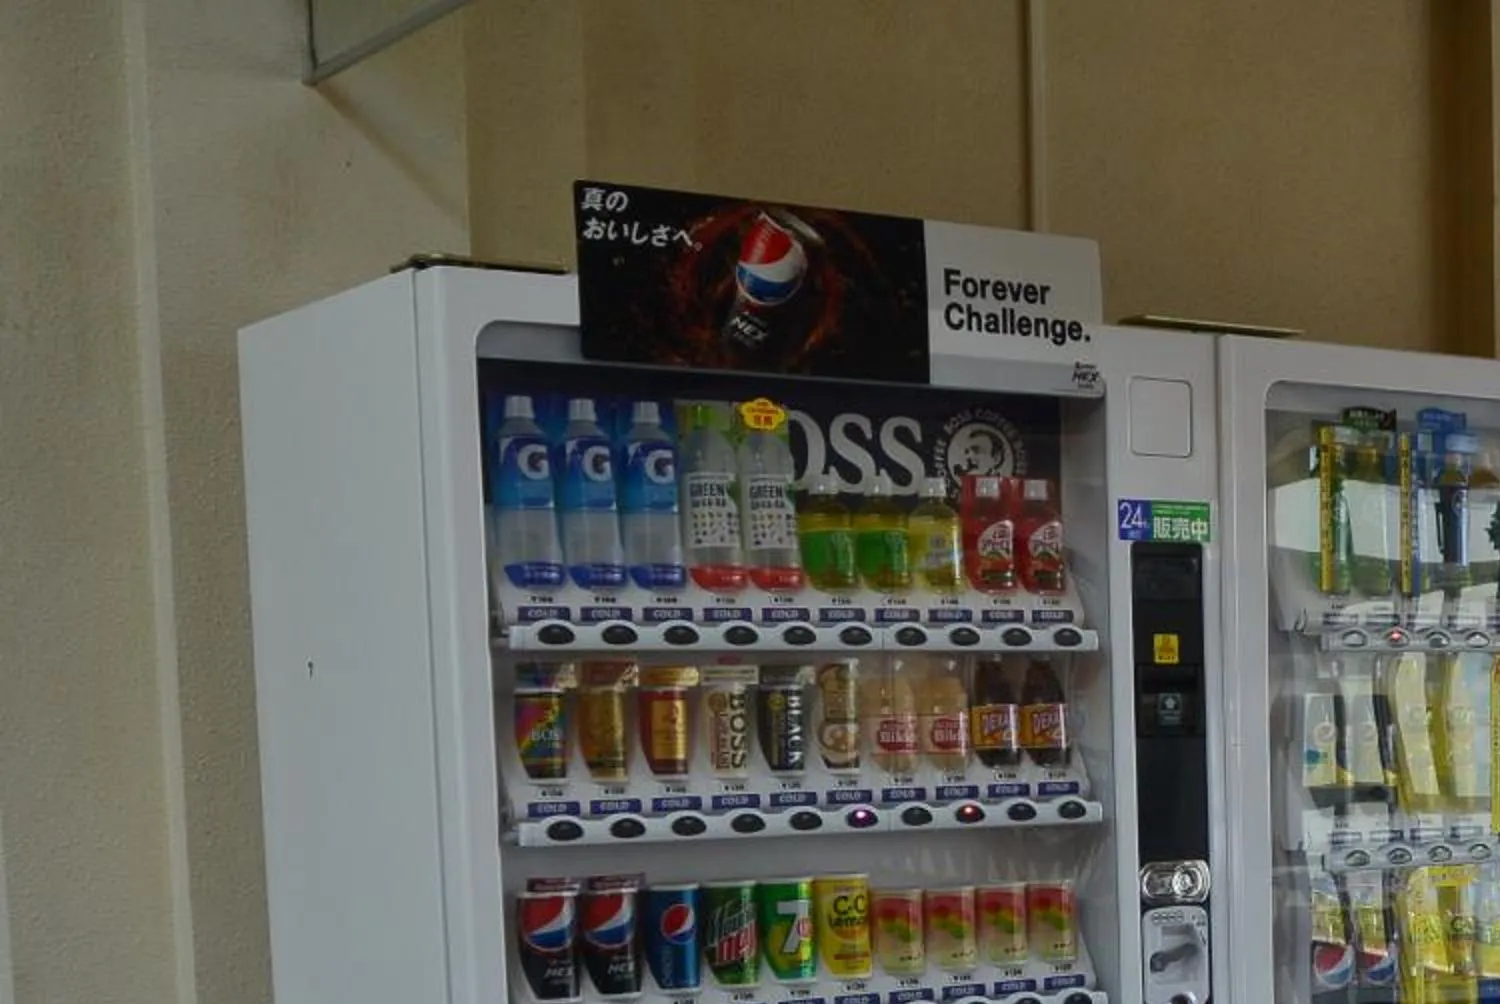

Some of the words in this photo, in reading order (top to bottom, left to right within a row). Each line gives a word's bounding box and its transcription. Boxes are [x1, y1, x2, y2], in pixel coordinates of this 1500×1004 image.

[581, 187, 629, 212] 真の
[582, 216, 702, 251] おいしさへ。
[943, 268, 1051, 305] Forever
[943, 303, 1092, 346] Challenge.
[728, 684, 748, 769] BOSS
[787, 685, 804, 767] BLACK
